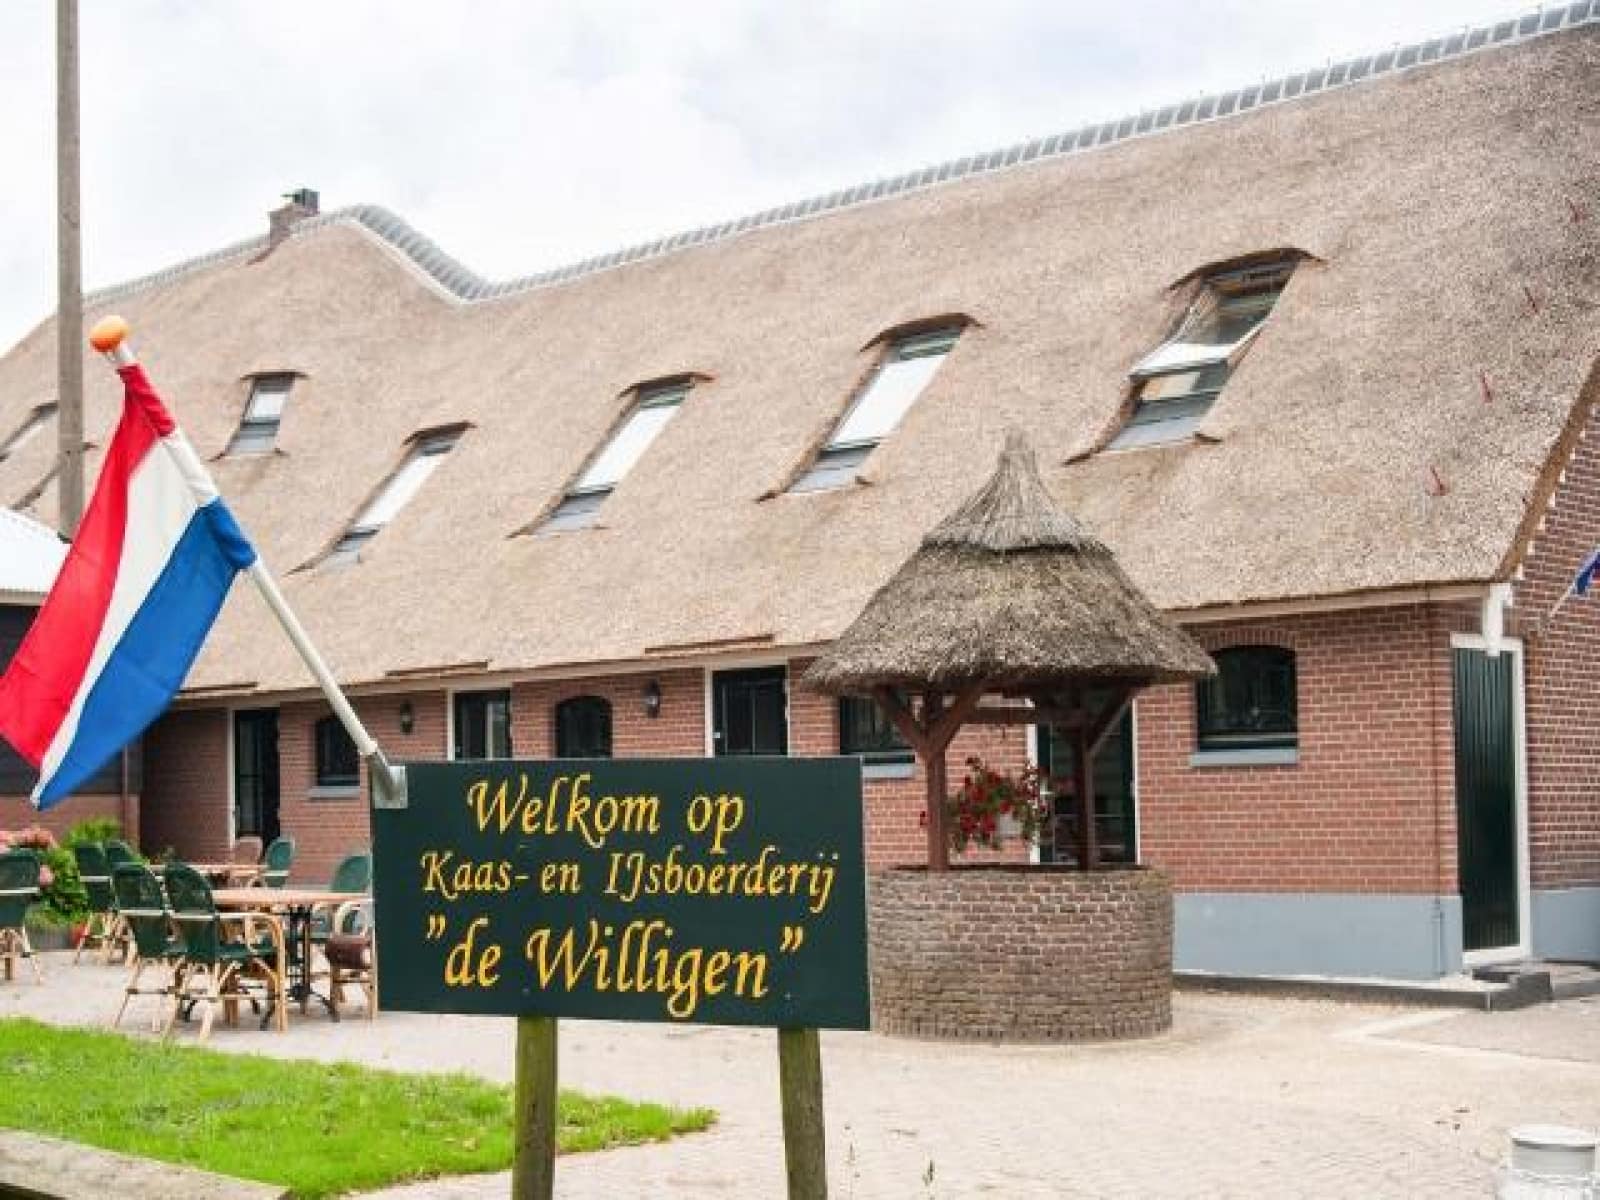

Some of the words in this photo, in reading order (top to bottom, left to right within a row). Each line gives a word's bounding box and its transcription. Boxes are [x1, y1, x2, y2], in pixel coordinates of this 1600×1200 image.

[467, 773, 661, 849] Welkom
[687, 793, 745, 855] op
[420, 849, 529, 900] Kaas-
[540, 862, 582, 893] en
[604, 845, 839, 914] IJsboerderij
